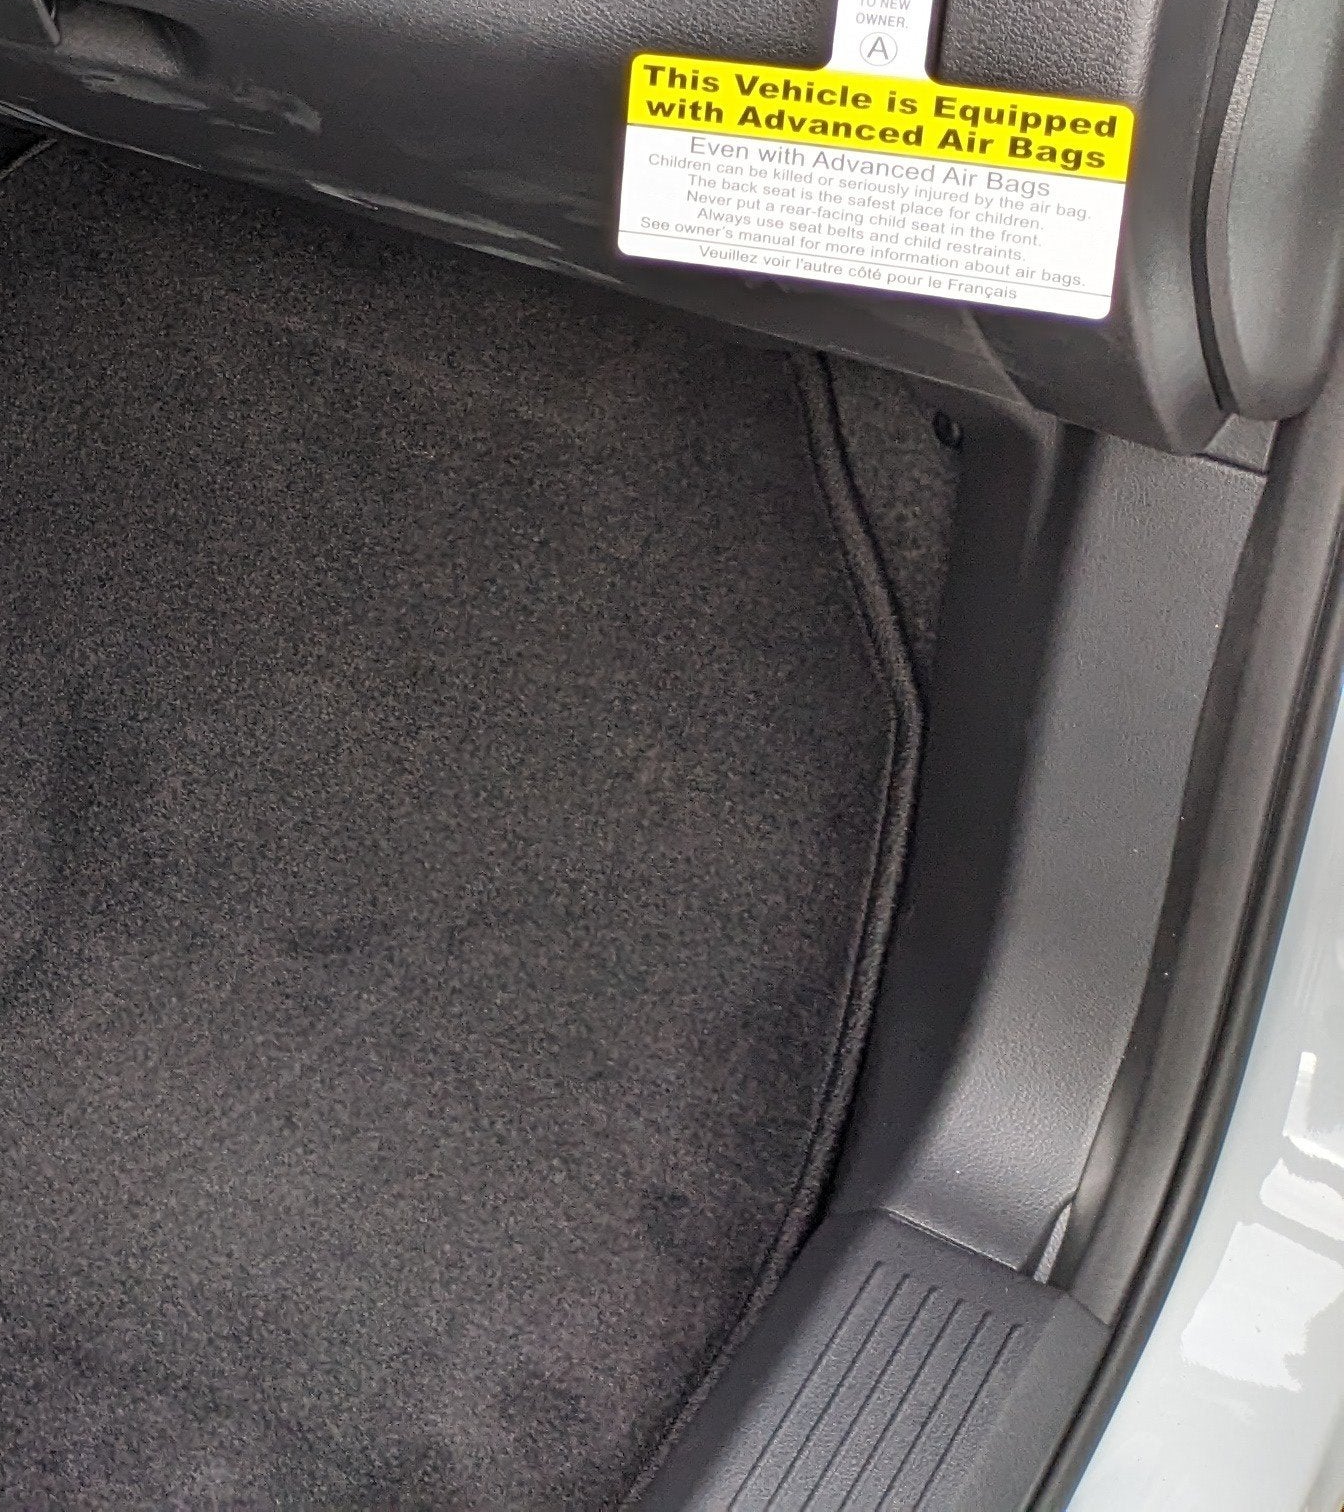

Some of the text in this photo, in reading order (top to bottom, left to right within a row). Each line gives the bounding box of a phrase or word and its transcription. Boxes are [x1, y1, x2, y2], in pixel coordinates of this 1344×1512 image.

[856, 12, 908, 29] OWNER.
[867, 36, 889, 60] A
[643, 64, 1117, 138] This Vehicle is Equipped
[646, 98, 1106, 171] with Advanced Air Bags
[648, 153, 1091, 222] Children can be killed or seriously injured by the air bag.
[690, 136, 1051, 199] Even with Advanced Air Bags
[686, 189, 1042, 247] Never put a rear-facing child seat in the front.
[688, 173, 1044, 230] The back seat is the safest place for children.
[640, 216, 670, 231] See
[738, 230, 795, 247] manual
[800, 237, 821, 251] for
[825, 241, 865, 256] more
[870, 246, 959, 269] information
[964, 259, 1010, 276] about
[1015, 266, 1036, 280] air
[1041, 268, 1086, 287] bags.
[697, 207, 1026, 262] Always use seat belts and child restraints.
[699, 244, 758, 264] Veuillez
[762, 255, 791, 268] voir
[848, 265, 881, 281] côté
[887, 270, 924, 286] pour
[928, 275, 942, 289] le
[947, 278, 1017, 299] Français
